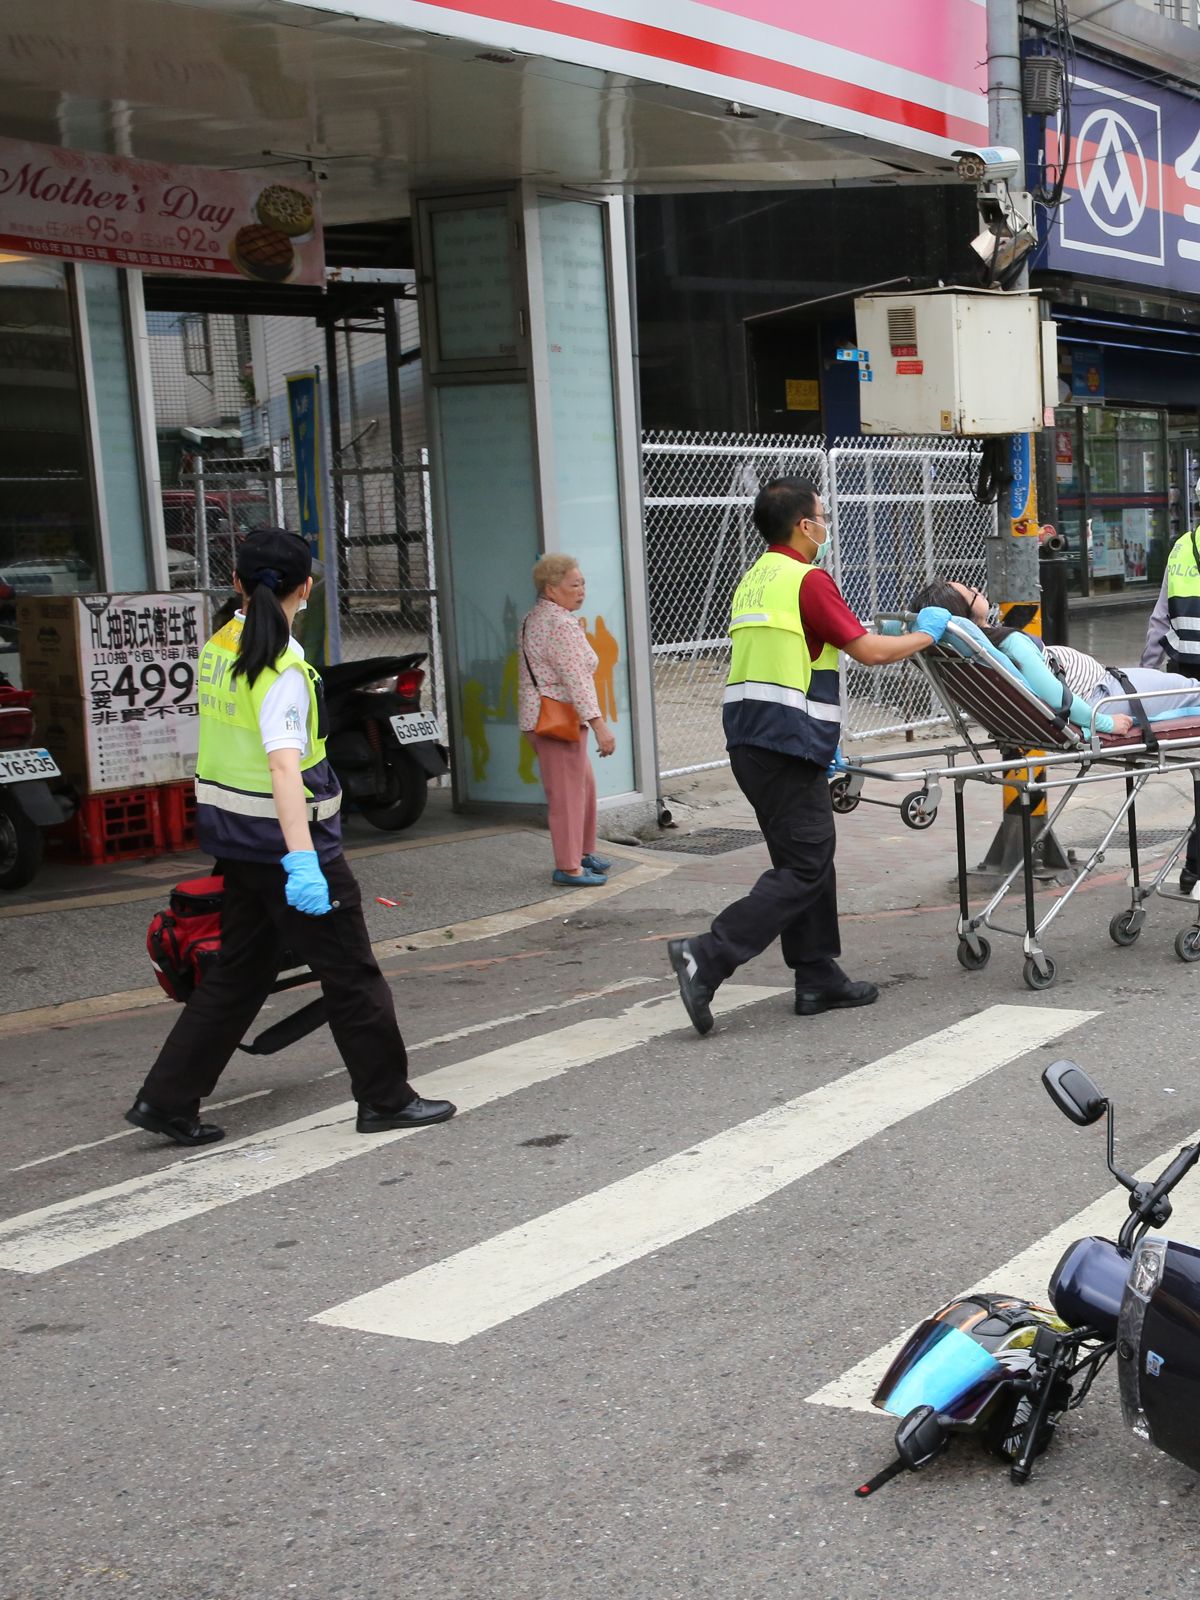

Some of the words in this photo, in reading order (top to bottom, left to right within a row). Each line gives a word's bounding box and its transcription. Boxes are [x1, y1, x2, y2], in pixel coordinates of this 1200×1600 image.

[0, 163, 146, 213] Mother's
[158, 185, 235, 232] Day
[1168, 564, 1199, 577] OLIC
[91, 669, 112, 710] 只要
[112, 661, 194, 707] 499
[91, 702, 199, 726] 非買不可
[396, 720, 439, 739] 639-BBT
